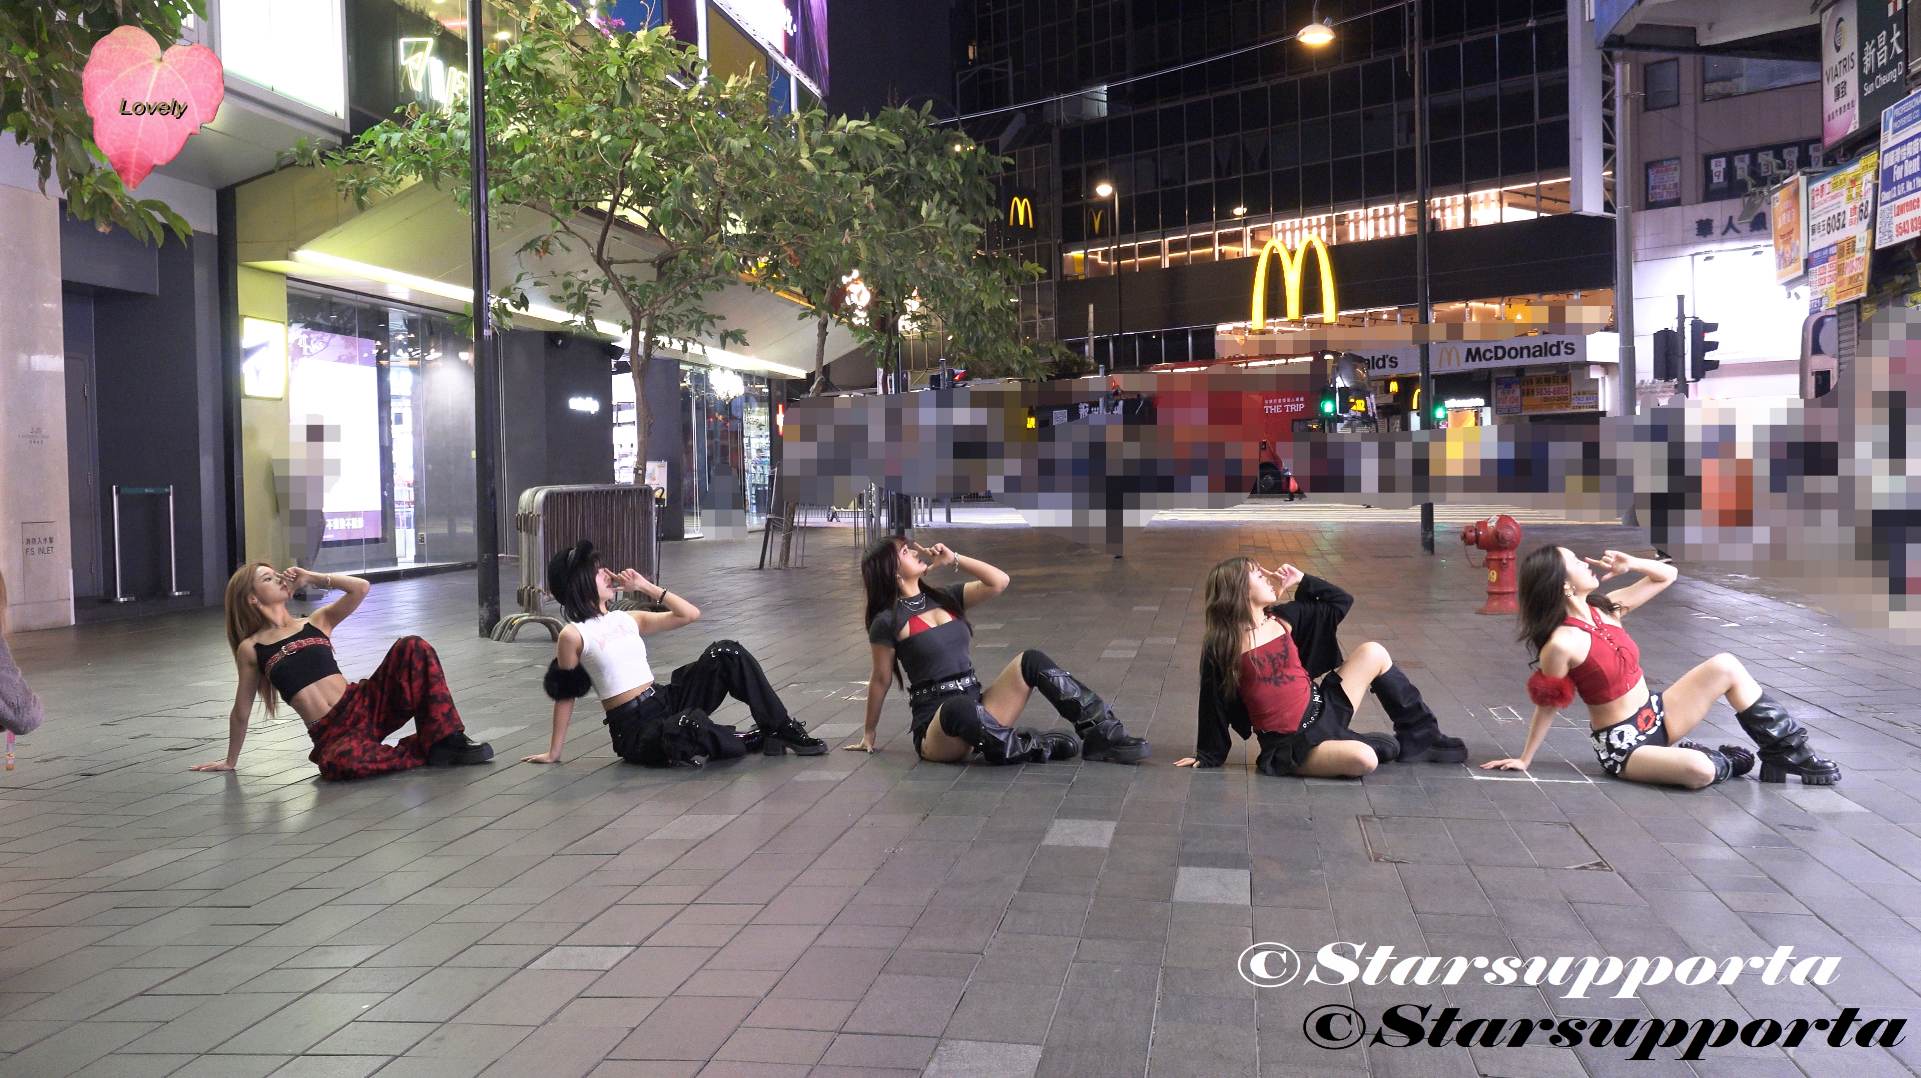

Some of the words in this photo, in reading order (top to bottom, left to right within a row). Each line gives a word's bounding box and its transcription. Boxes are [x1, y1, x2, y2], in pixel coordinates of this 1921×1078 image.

[1825, 51, 1855, 85] VIATRIS
[1864, 82, 1875, 97] Sun
[1875, 68, 1897, 89] Cheung
[1894, 197, 1920, 217] Lawrence
[1826, 210, 1846, 235] 6052
[1465, 340, 1576, 363] McDonald's
[1264, 404, 1282, 414] THE
[1284, 403, 1305, 413] TRIP
[37, 546, 54, 556] INLET
